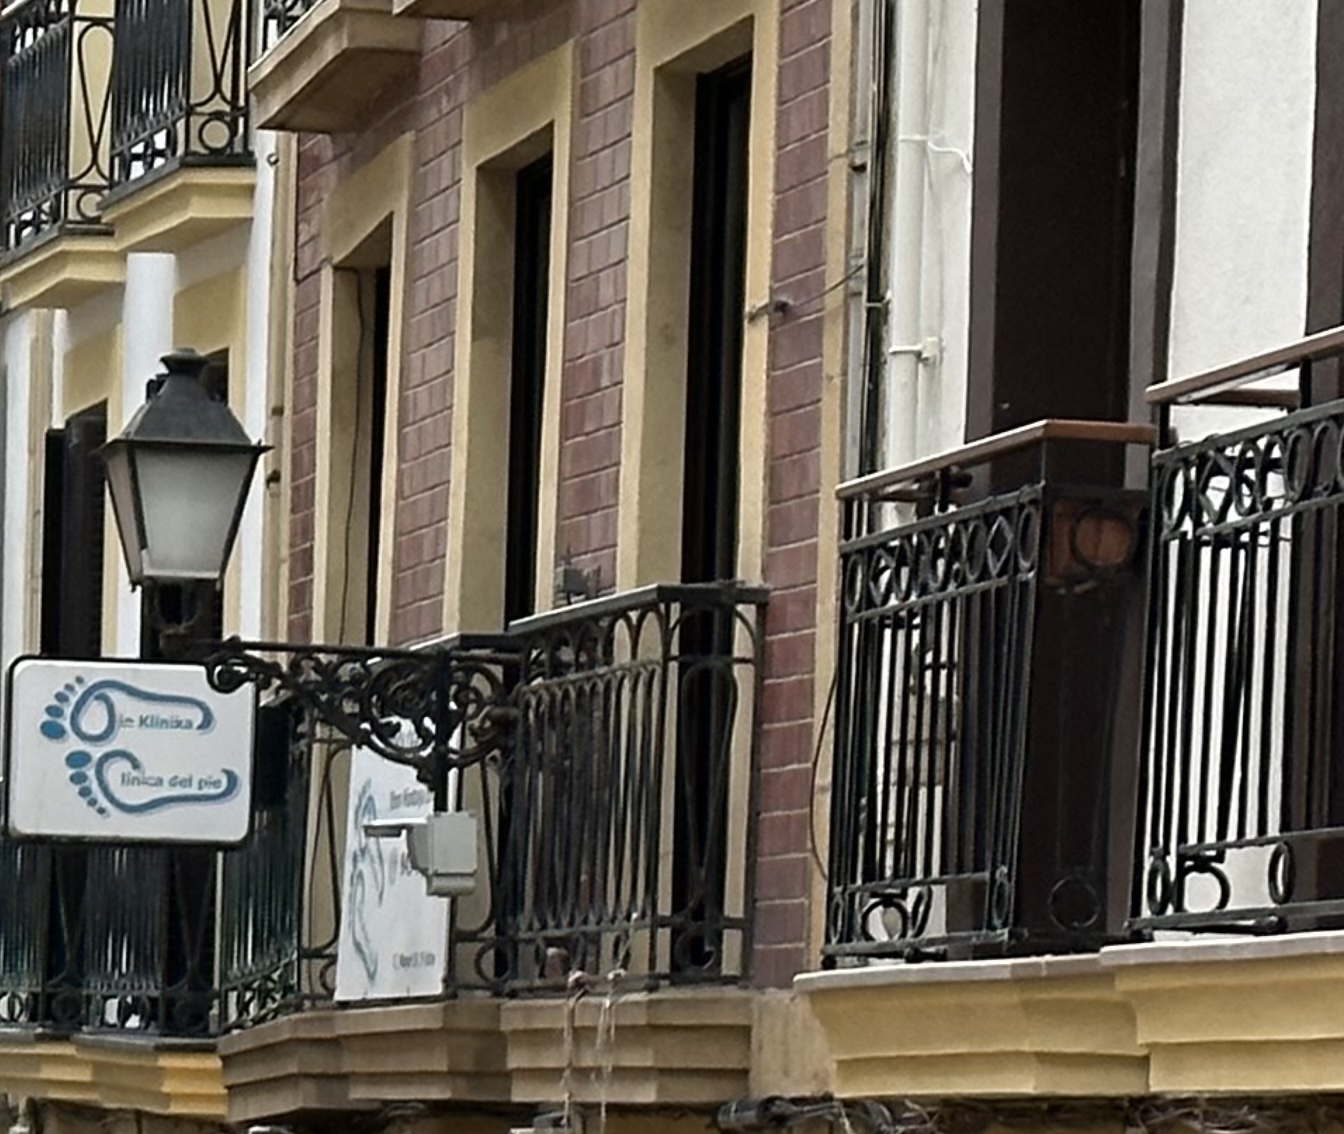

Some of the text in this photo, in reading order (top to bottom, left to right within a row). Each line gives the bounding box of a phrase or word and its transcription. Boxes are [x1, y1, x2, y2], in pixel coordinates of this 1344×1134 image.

[138, 713, 194, 730] Klinika
[167, 774, 193, 789] del
[197, 775, 223, 791] pie
